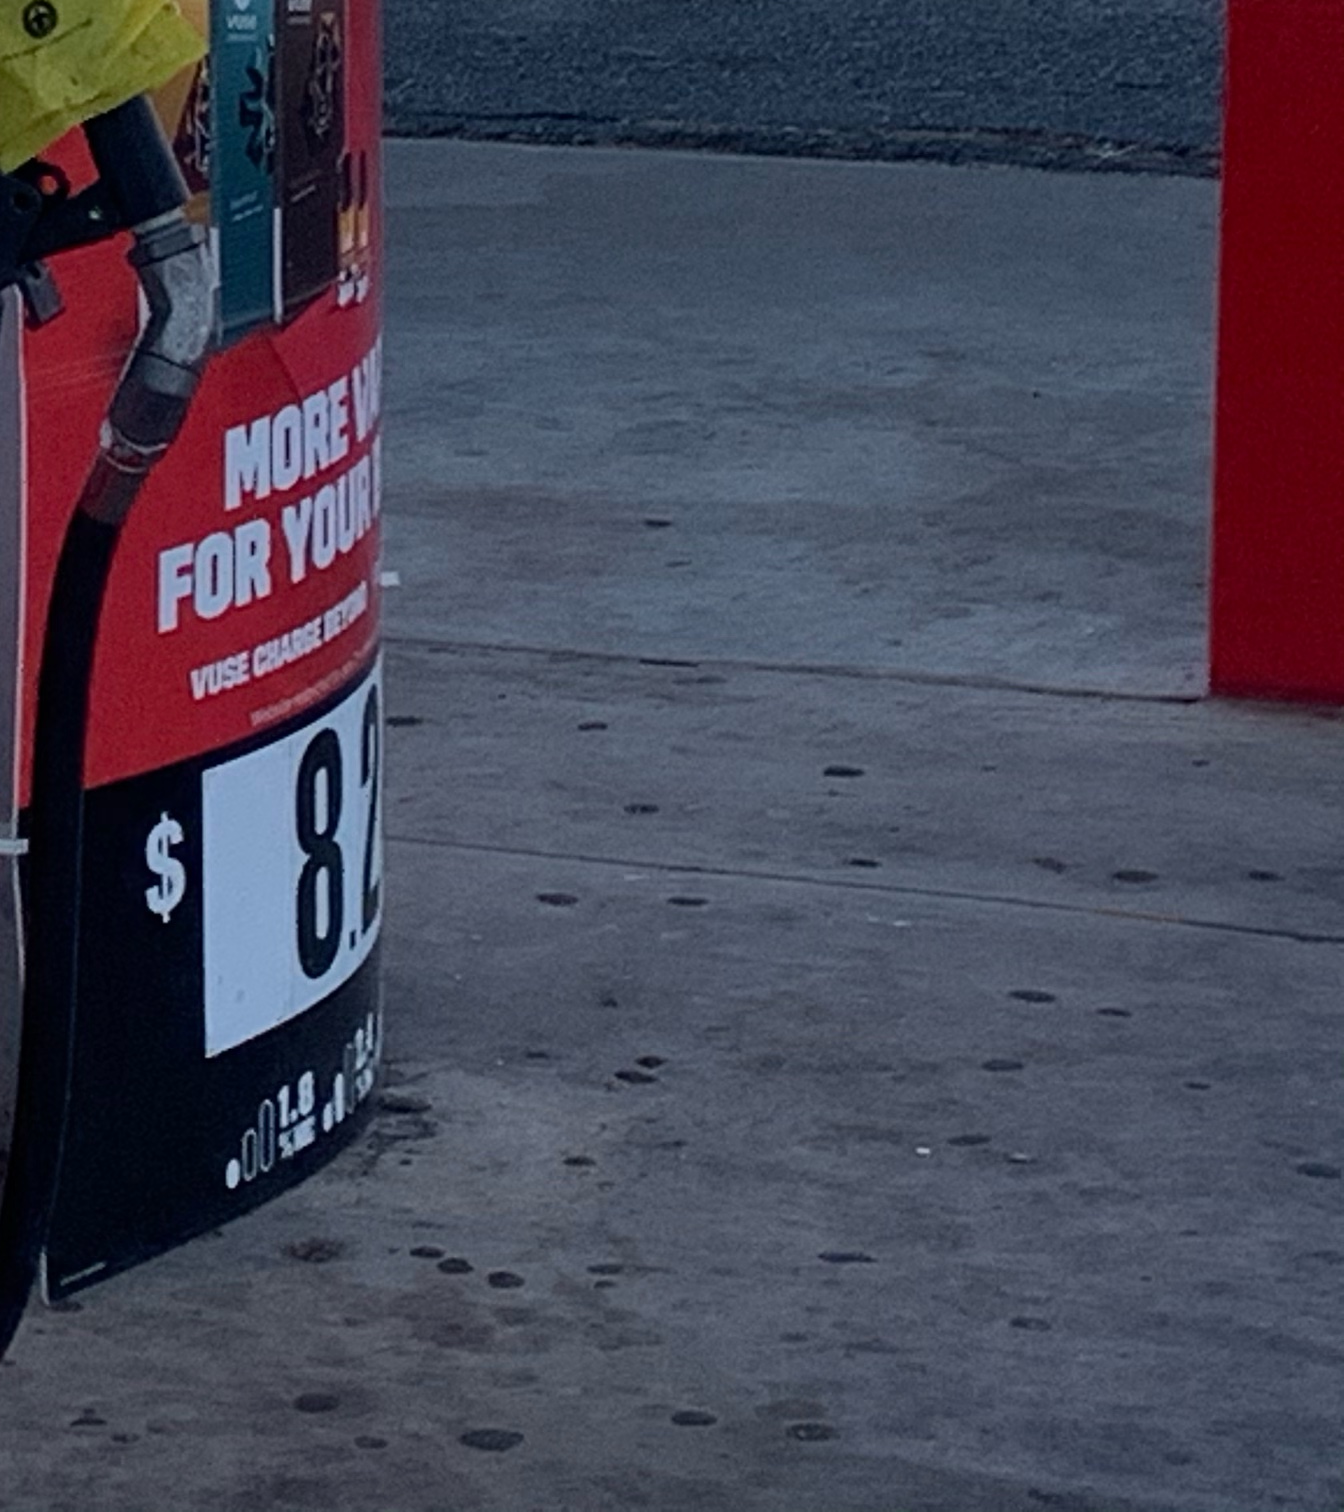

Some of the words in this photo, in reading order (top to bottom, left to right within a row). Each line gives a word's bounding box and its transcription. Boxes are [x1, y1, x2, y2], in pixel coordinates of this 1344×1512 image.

[223, 376, 349, 511] MORE
[157, 518, 272, 634] FOR
[282, 454, 372, 583] YOUR
[189, 651, 251, 700] VUSE
[252, 618, 322, 676] CHARGE
[144, 810, 187, 924] $
[277, 1071, 315, 1129] 1.8
